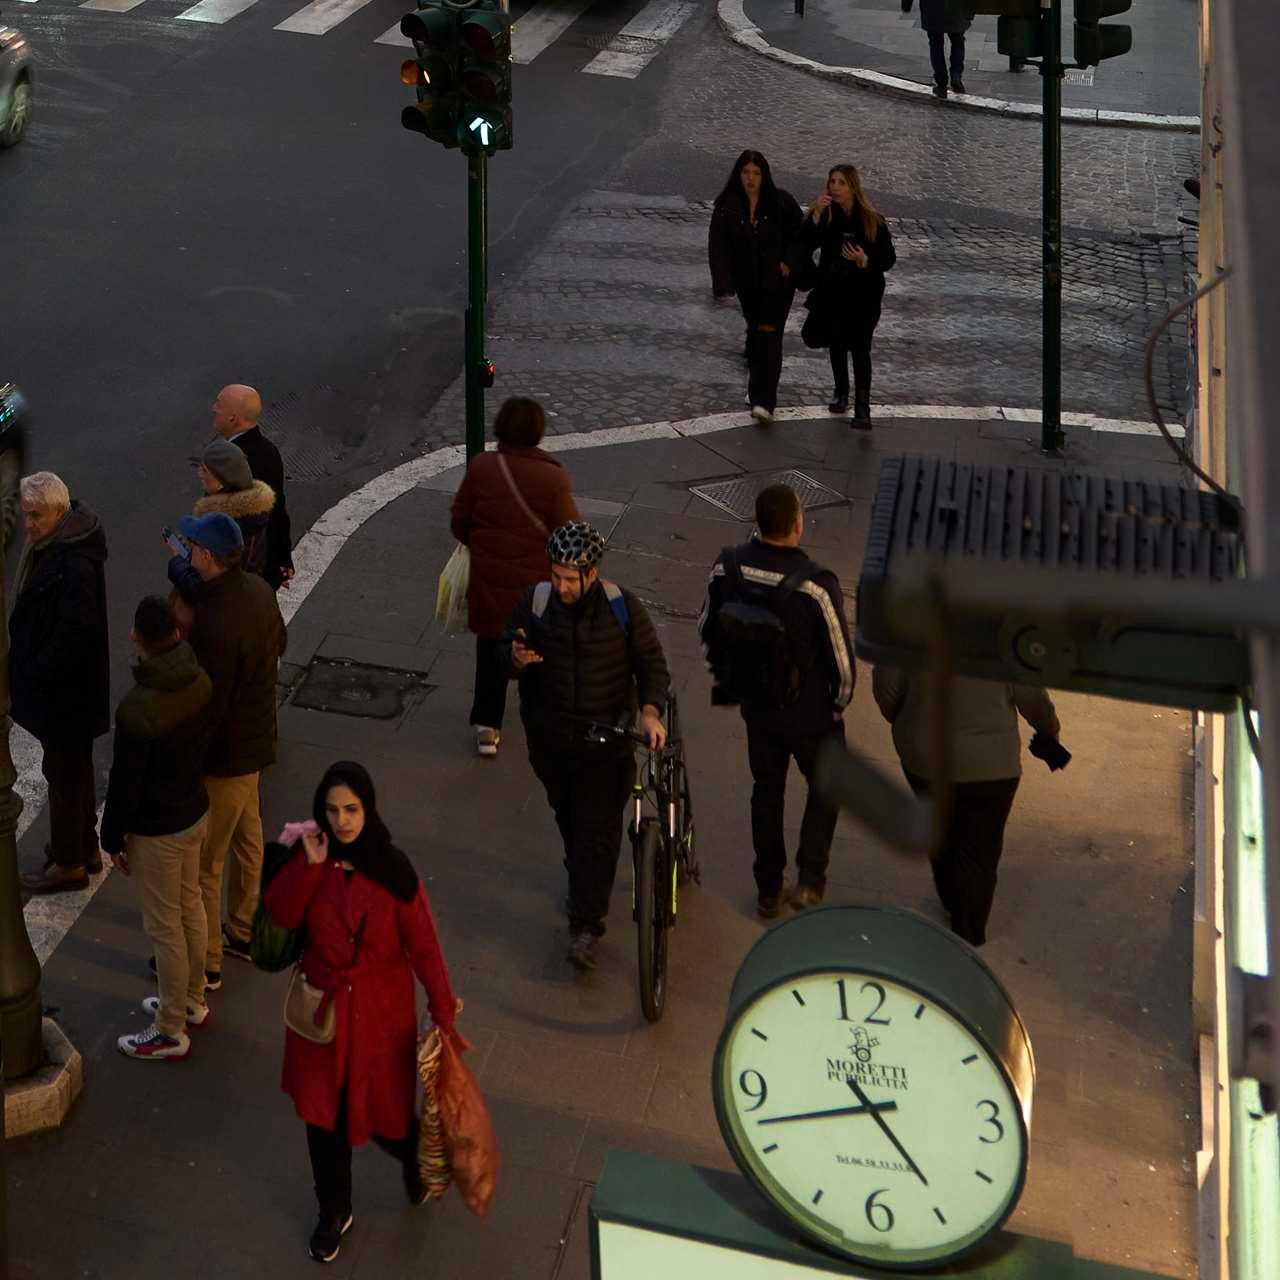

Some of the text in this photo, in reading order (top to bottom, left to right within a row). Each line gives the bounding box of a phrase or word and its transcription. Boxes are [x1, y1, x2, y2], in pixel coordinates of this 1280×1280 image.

[832, 979, 891, 1026] 12
[739, 1068, 767, 1111] 9
[826, 1057, 906, 1079] MORETTI
[976, 1099, 1004, 1144] 3
[866, 1189, 894, 1232] 6
